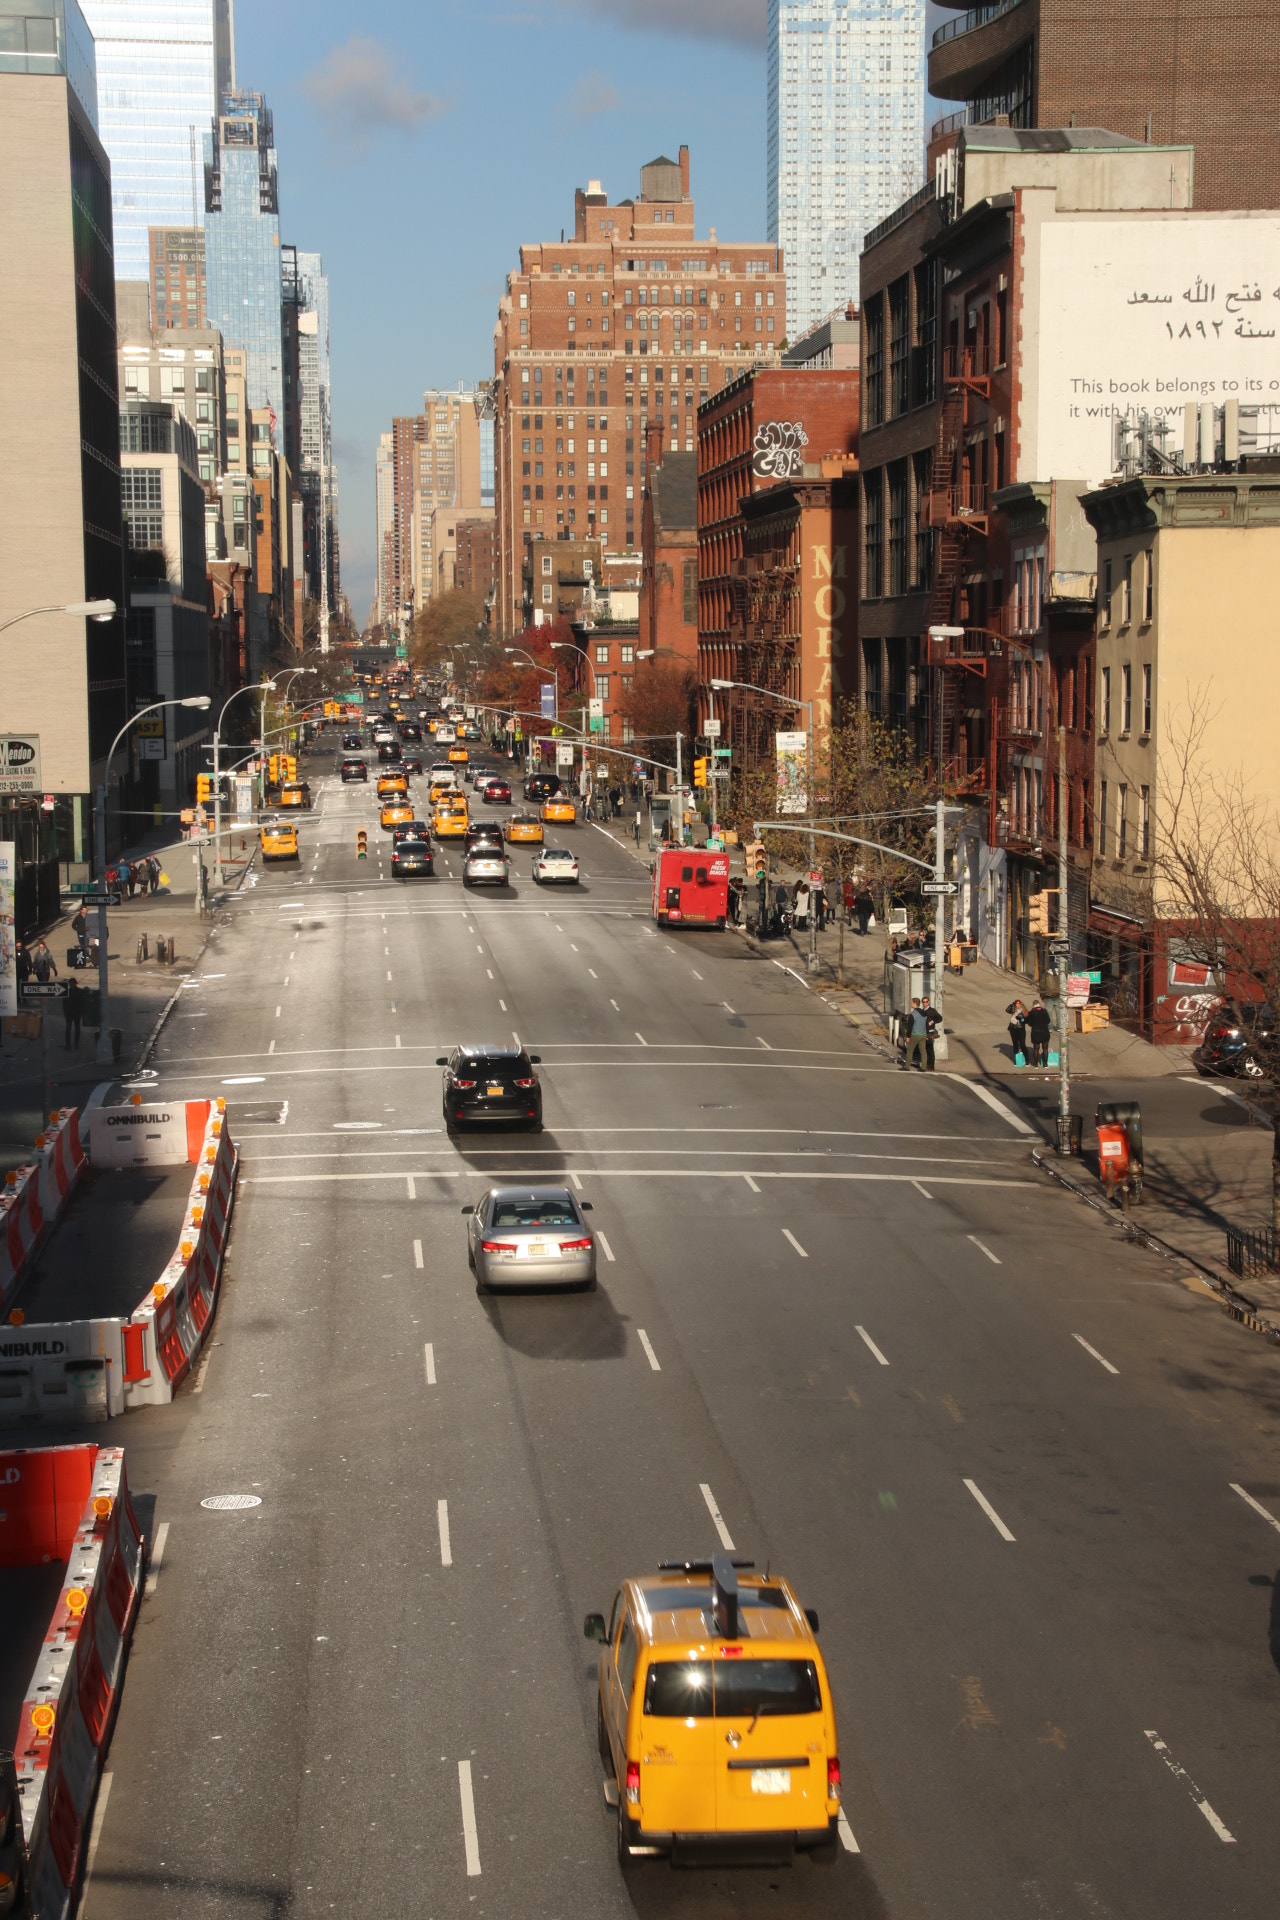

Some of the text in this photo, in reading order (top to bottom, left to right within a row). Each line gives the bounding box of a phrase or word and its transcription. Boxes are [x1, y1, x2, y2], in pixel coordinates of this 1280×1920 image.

[1127, 291, 1173, 305] سعد
[1225, 282, 1262, 313] فتح
[1165, 317, 1276, 341] سنة ١٨٩٢
[1070, 378, 1103, 394] This
[1109, 377, 1150, 393] book
[1156, 376, 1216, 396] belongs
[1222, 379, 1239, 391] to
[1245, 376, 1262, 391] its
[1069, 403, 1080, 418] it
[1085, 402, 1120, 418] with
[1126, 402, 1147, 418] his
[106, 1113, 170, 1126] OMNIBUILD
